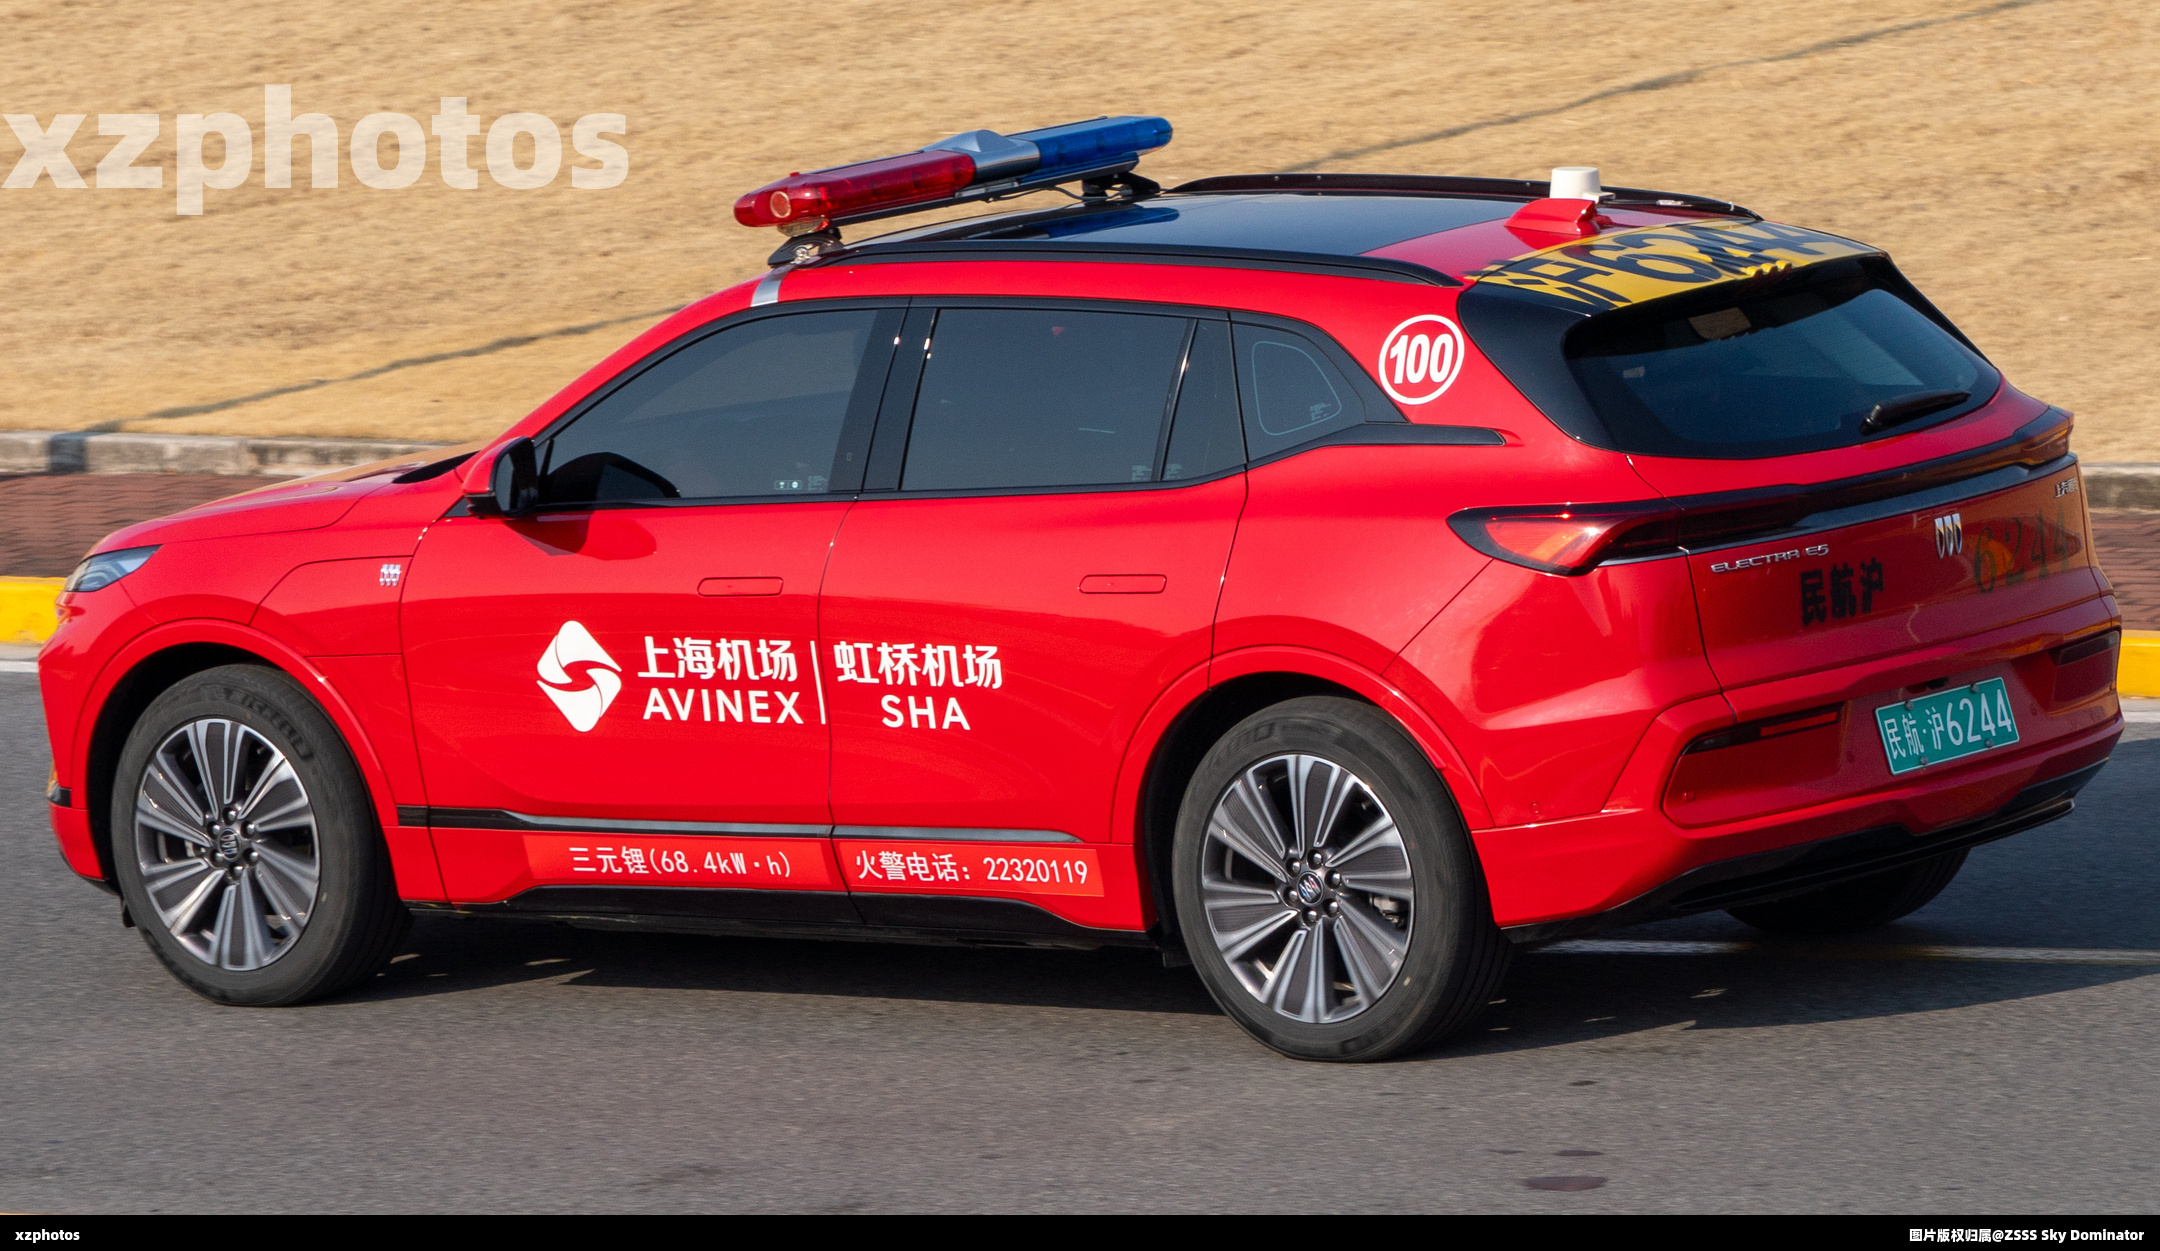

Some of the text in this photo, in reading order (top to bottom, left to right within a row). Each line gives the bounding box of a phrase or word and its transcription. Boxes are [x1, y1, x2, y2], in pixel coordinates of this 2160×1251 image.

[1389, 333, 1454, 386] 100
[1711, 544, 1829, 573] ELECTRA E5
[1800, 503, 2071, 627] 民航沪 6244
[636, 635, 798, 683] 上海机场
[834, 640, 1003, 691] 虹桥机场
[642, 688, 804, 725] AVINEX
[881, 694, 971, 731] SHA
